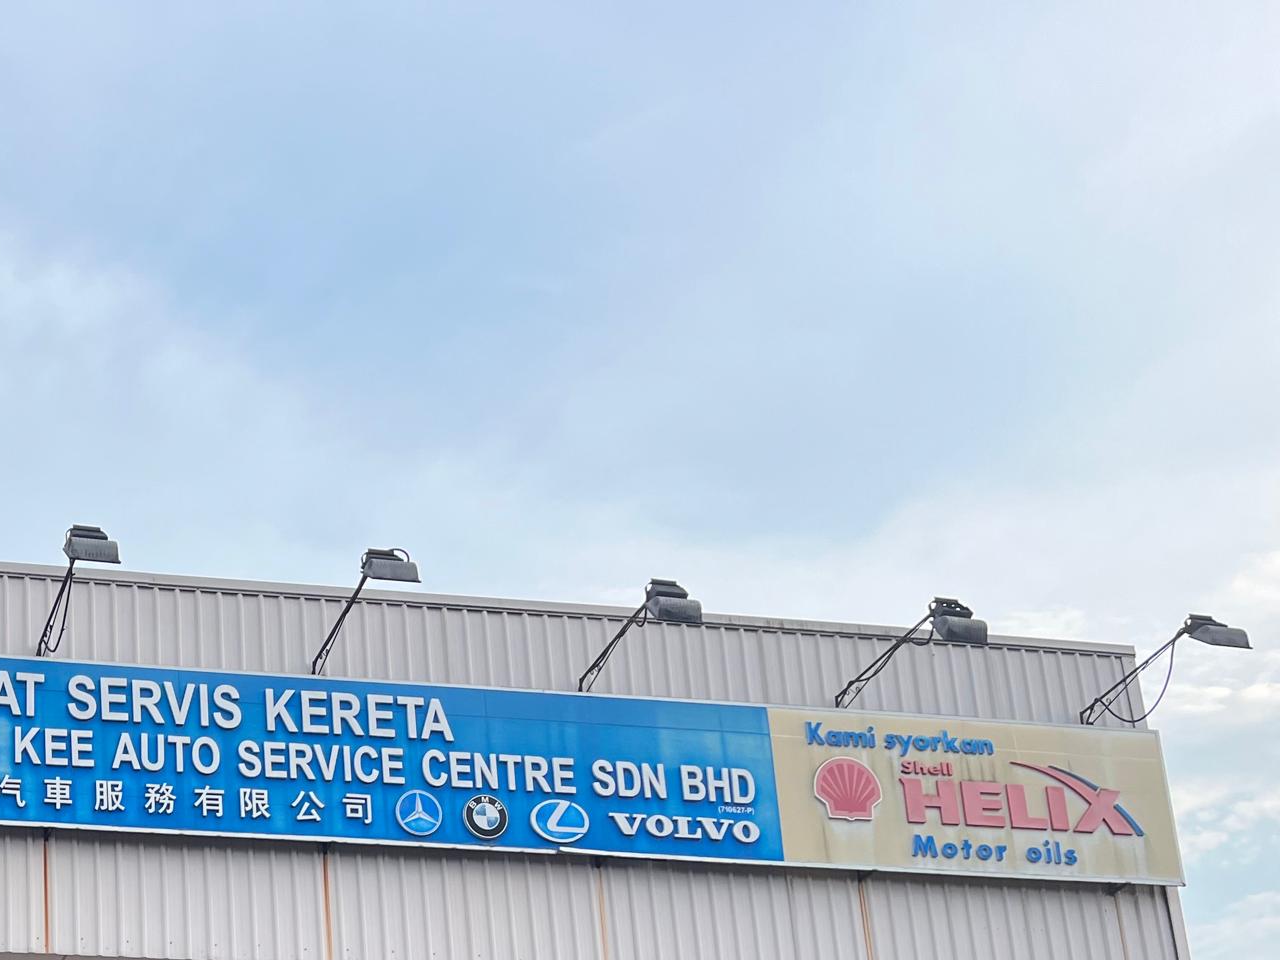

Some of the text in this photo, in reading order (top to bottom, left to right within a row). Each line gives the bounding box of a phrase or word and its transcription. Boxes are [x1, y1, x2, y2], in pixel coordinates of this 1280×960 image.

[67, 675, 242, 729] SERVIS
[264, 688, 455, 742] KERETA
[805, 721, 994, 757] Kami syorkan
[14, 726, 95, 768] KEE
[111, 732, 220, 775] AUTO
[238, 739, 406, 785] SERVICE
[422, 749, 577, 795] CENTRE
[591, 759, 668, 799] SDN
[679, 764, 756, 804] BHD
[900, 759, 953, 777] Shell
[469, 796, 503, 811] BMW
[898, 768, 1140, 836] HELIX
[609, 812, 761, 844] VOLVO
[911, 834, 1078, 866] Motor oils
